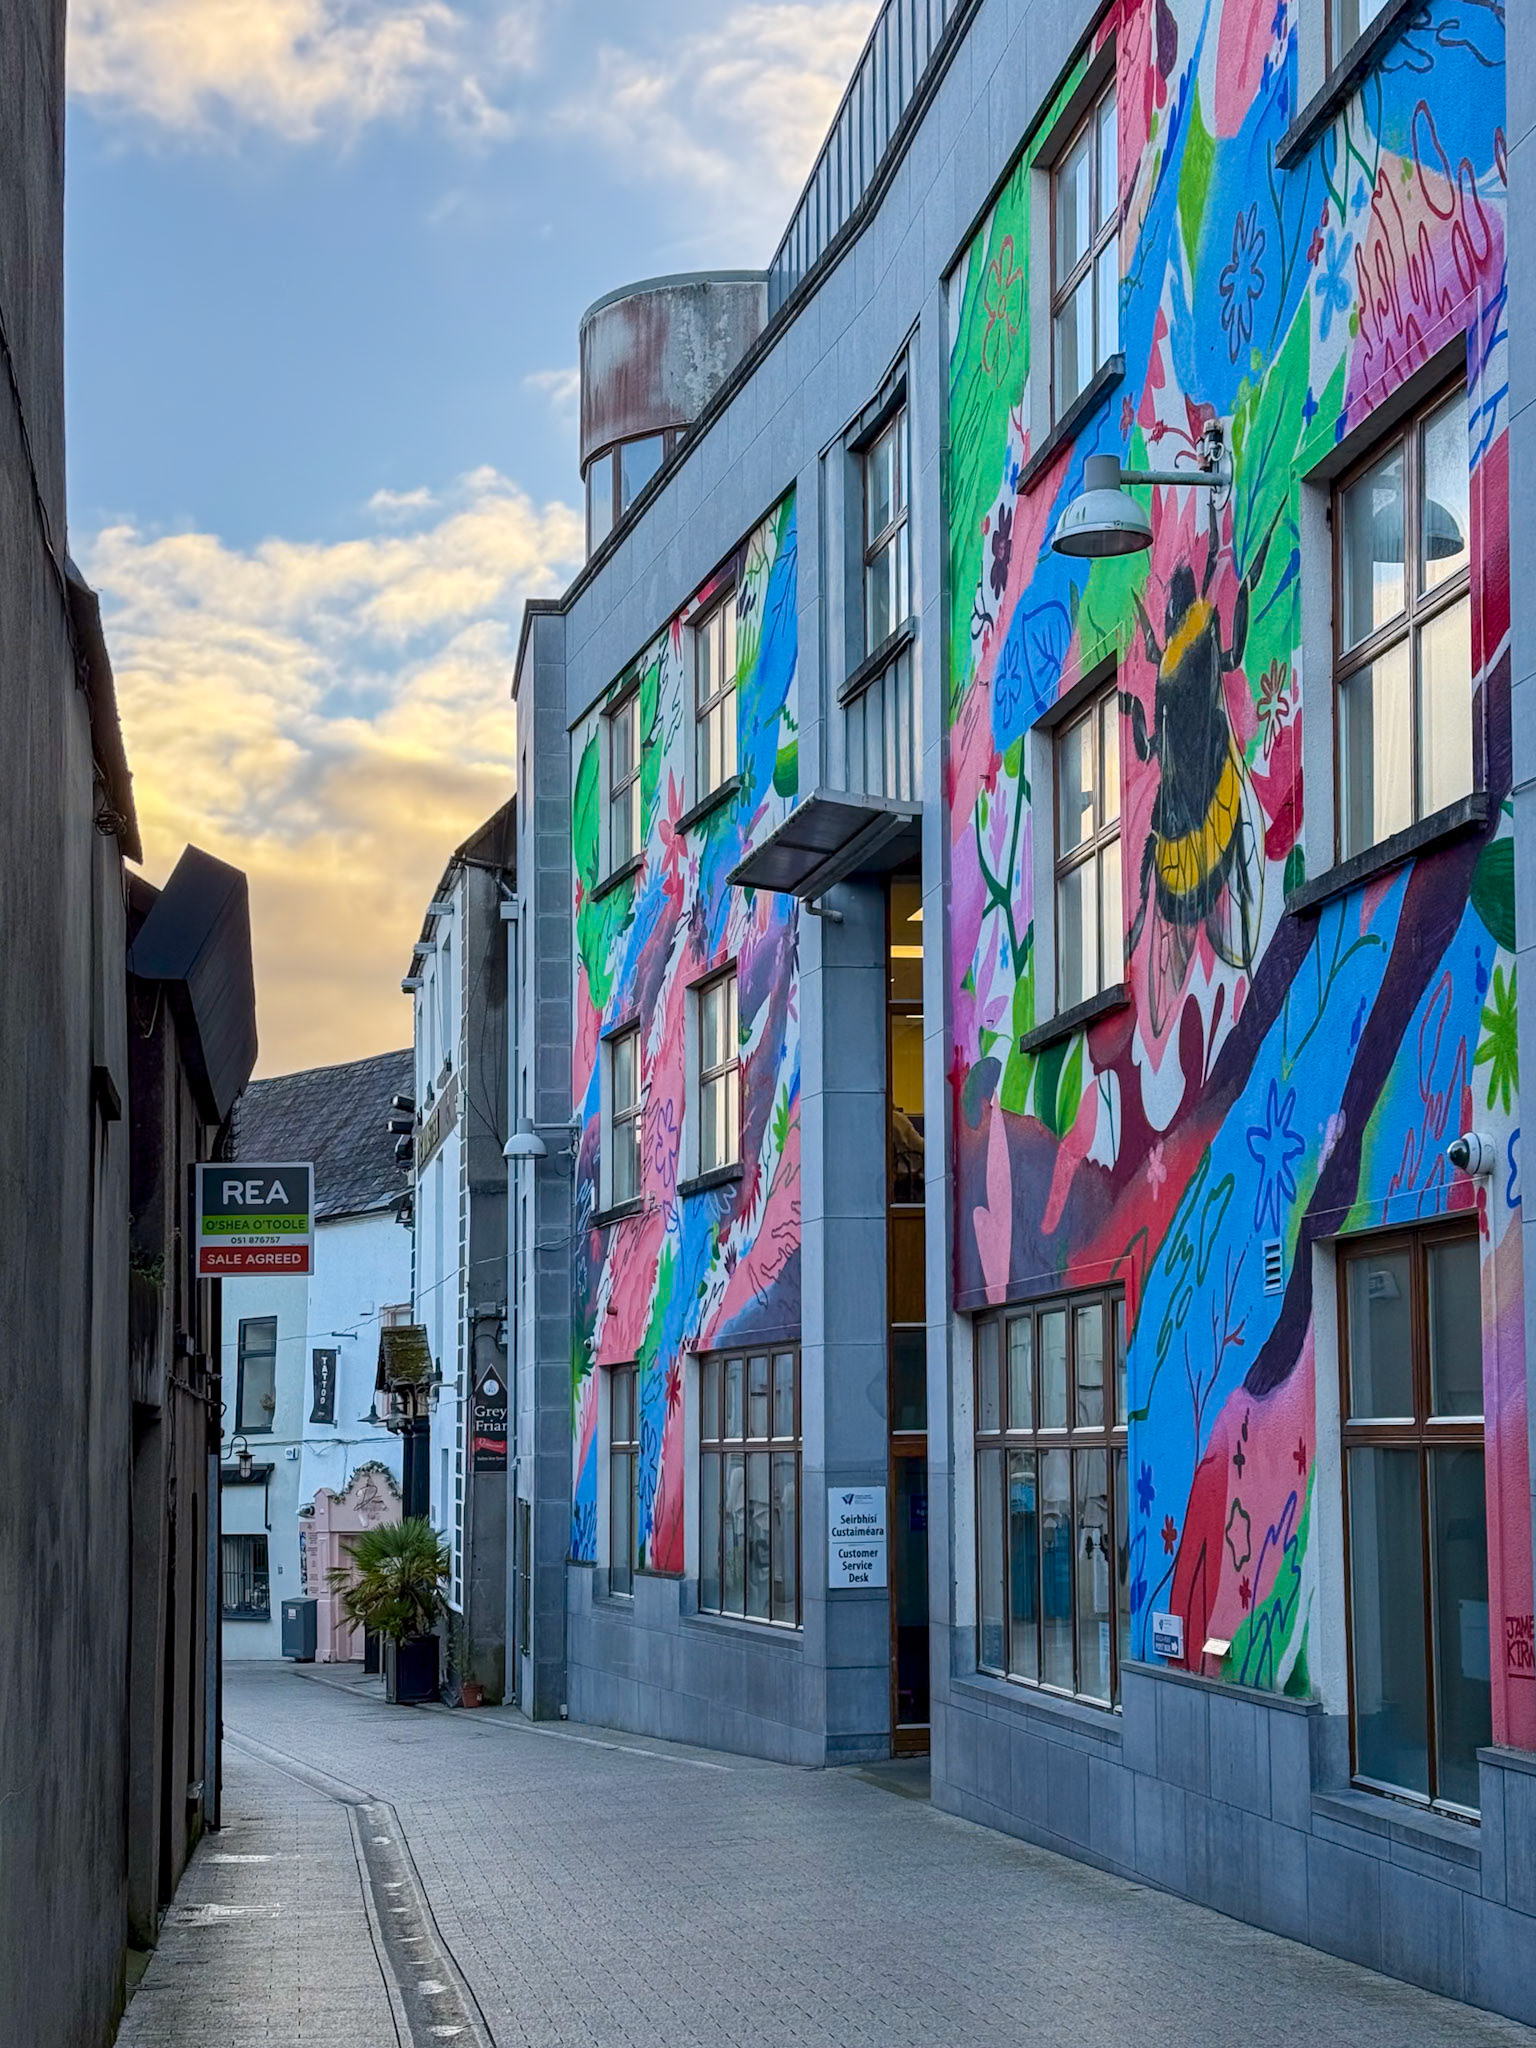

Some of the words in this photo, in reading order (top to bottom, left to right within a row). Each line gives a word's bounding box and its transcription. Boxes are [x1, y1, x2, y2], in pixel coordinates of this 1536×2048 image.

[222, 1180, 289, 1205] REA
[206, 1220, 250, 1231] O'SHEA
[252, 1219, 306, 1230] O'TOOLE
[248, 1236, 281, 1244] 876757
[207, 1254, 242, 1265] SALE
[245, 1253, 302, 1265] AGREED
[320, 1356, 328, 1405] TATTOO
[474, 1405, 507, 1420] Grey
[831, 1526, 884, 1537] Custaiméara
[838, 1548, 878, 1558] Customer
[842, 1560, 873, 1570] Service
[848, 1573, 869, 1583] Desk
